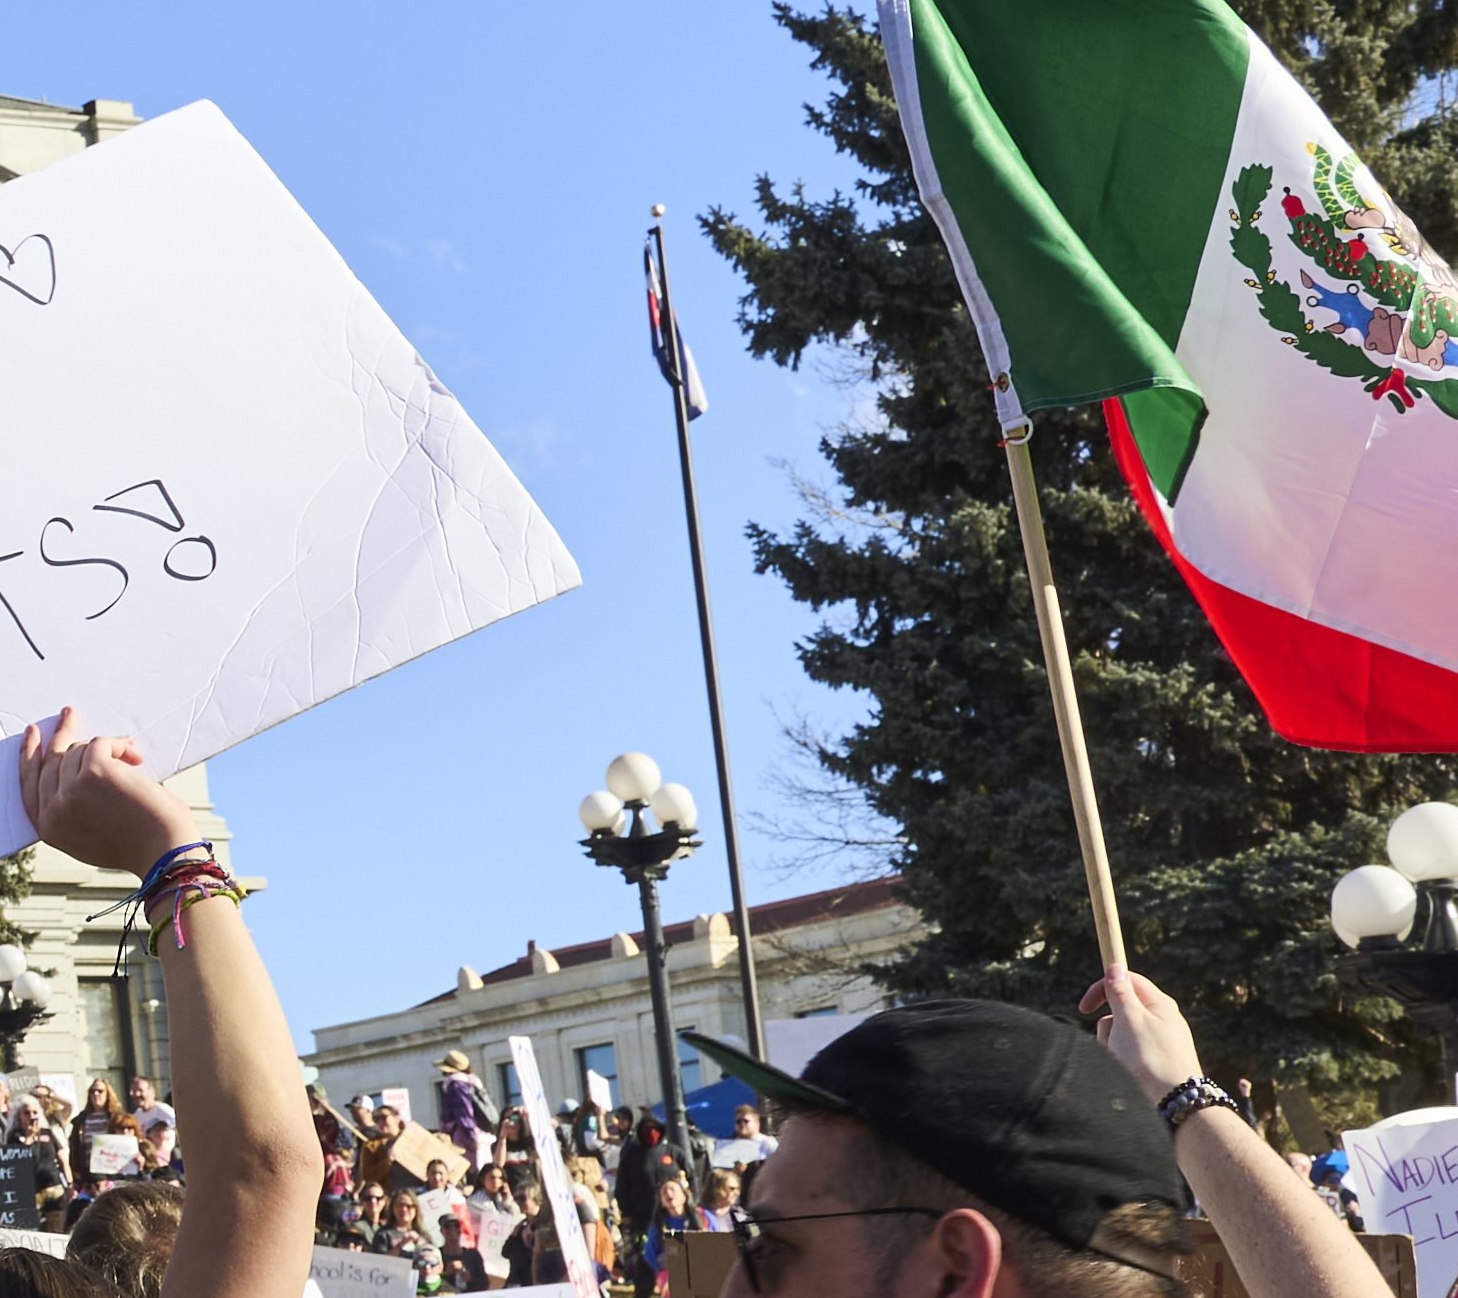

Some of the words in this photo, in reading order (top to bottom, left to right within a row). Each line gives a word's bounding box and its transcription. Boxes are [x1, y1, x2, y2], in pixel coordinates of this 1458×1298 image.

[0, 1147, 33, 1161] WOMAN
[3, 1192, 17, 1204] I
[0, 1211, 15, 1225] AS
[310, 1261, 344, 1282] hool
[348, 1264, 362, 1281] is
[369, 1266, 393, 1285] for
